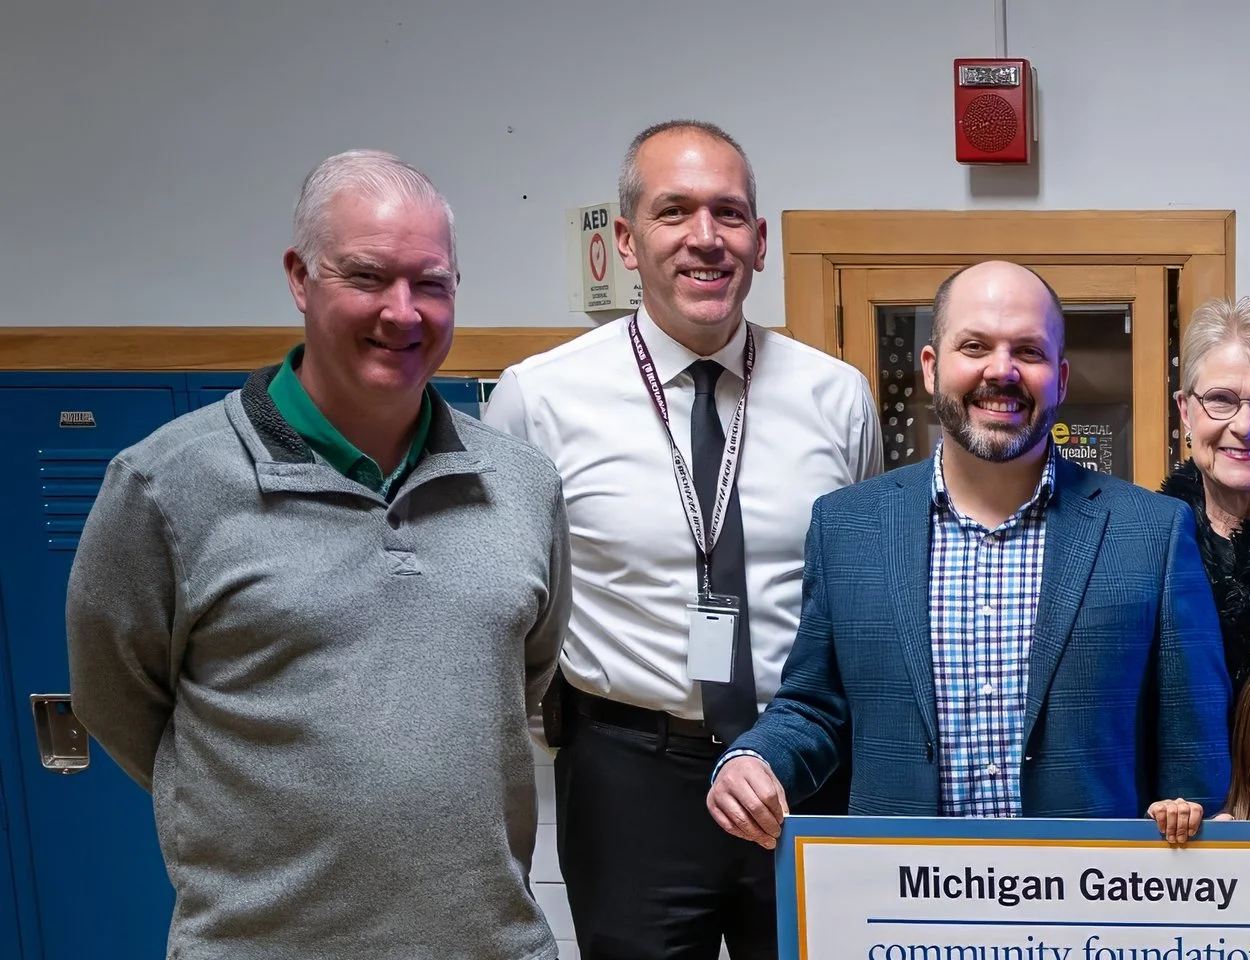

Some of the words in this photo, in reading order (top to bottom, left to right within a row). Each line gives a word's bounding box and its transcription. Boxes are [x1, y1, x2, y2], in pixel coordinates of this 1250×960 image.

[583, 208, 608, 231] AED
[1071, 425, 1112, 435] SPECIAL
[899, 865, 1064, 906] Michigan
[1079, 868, 1238, 910] Gateway
